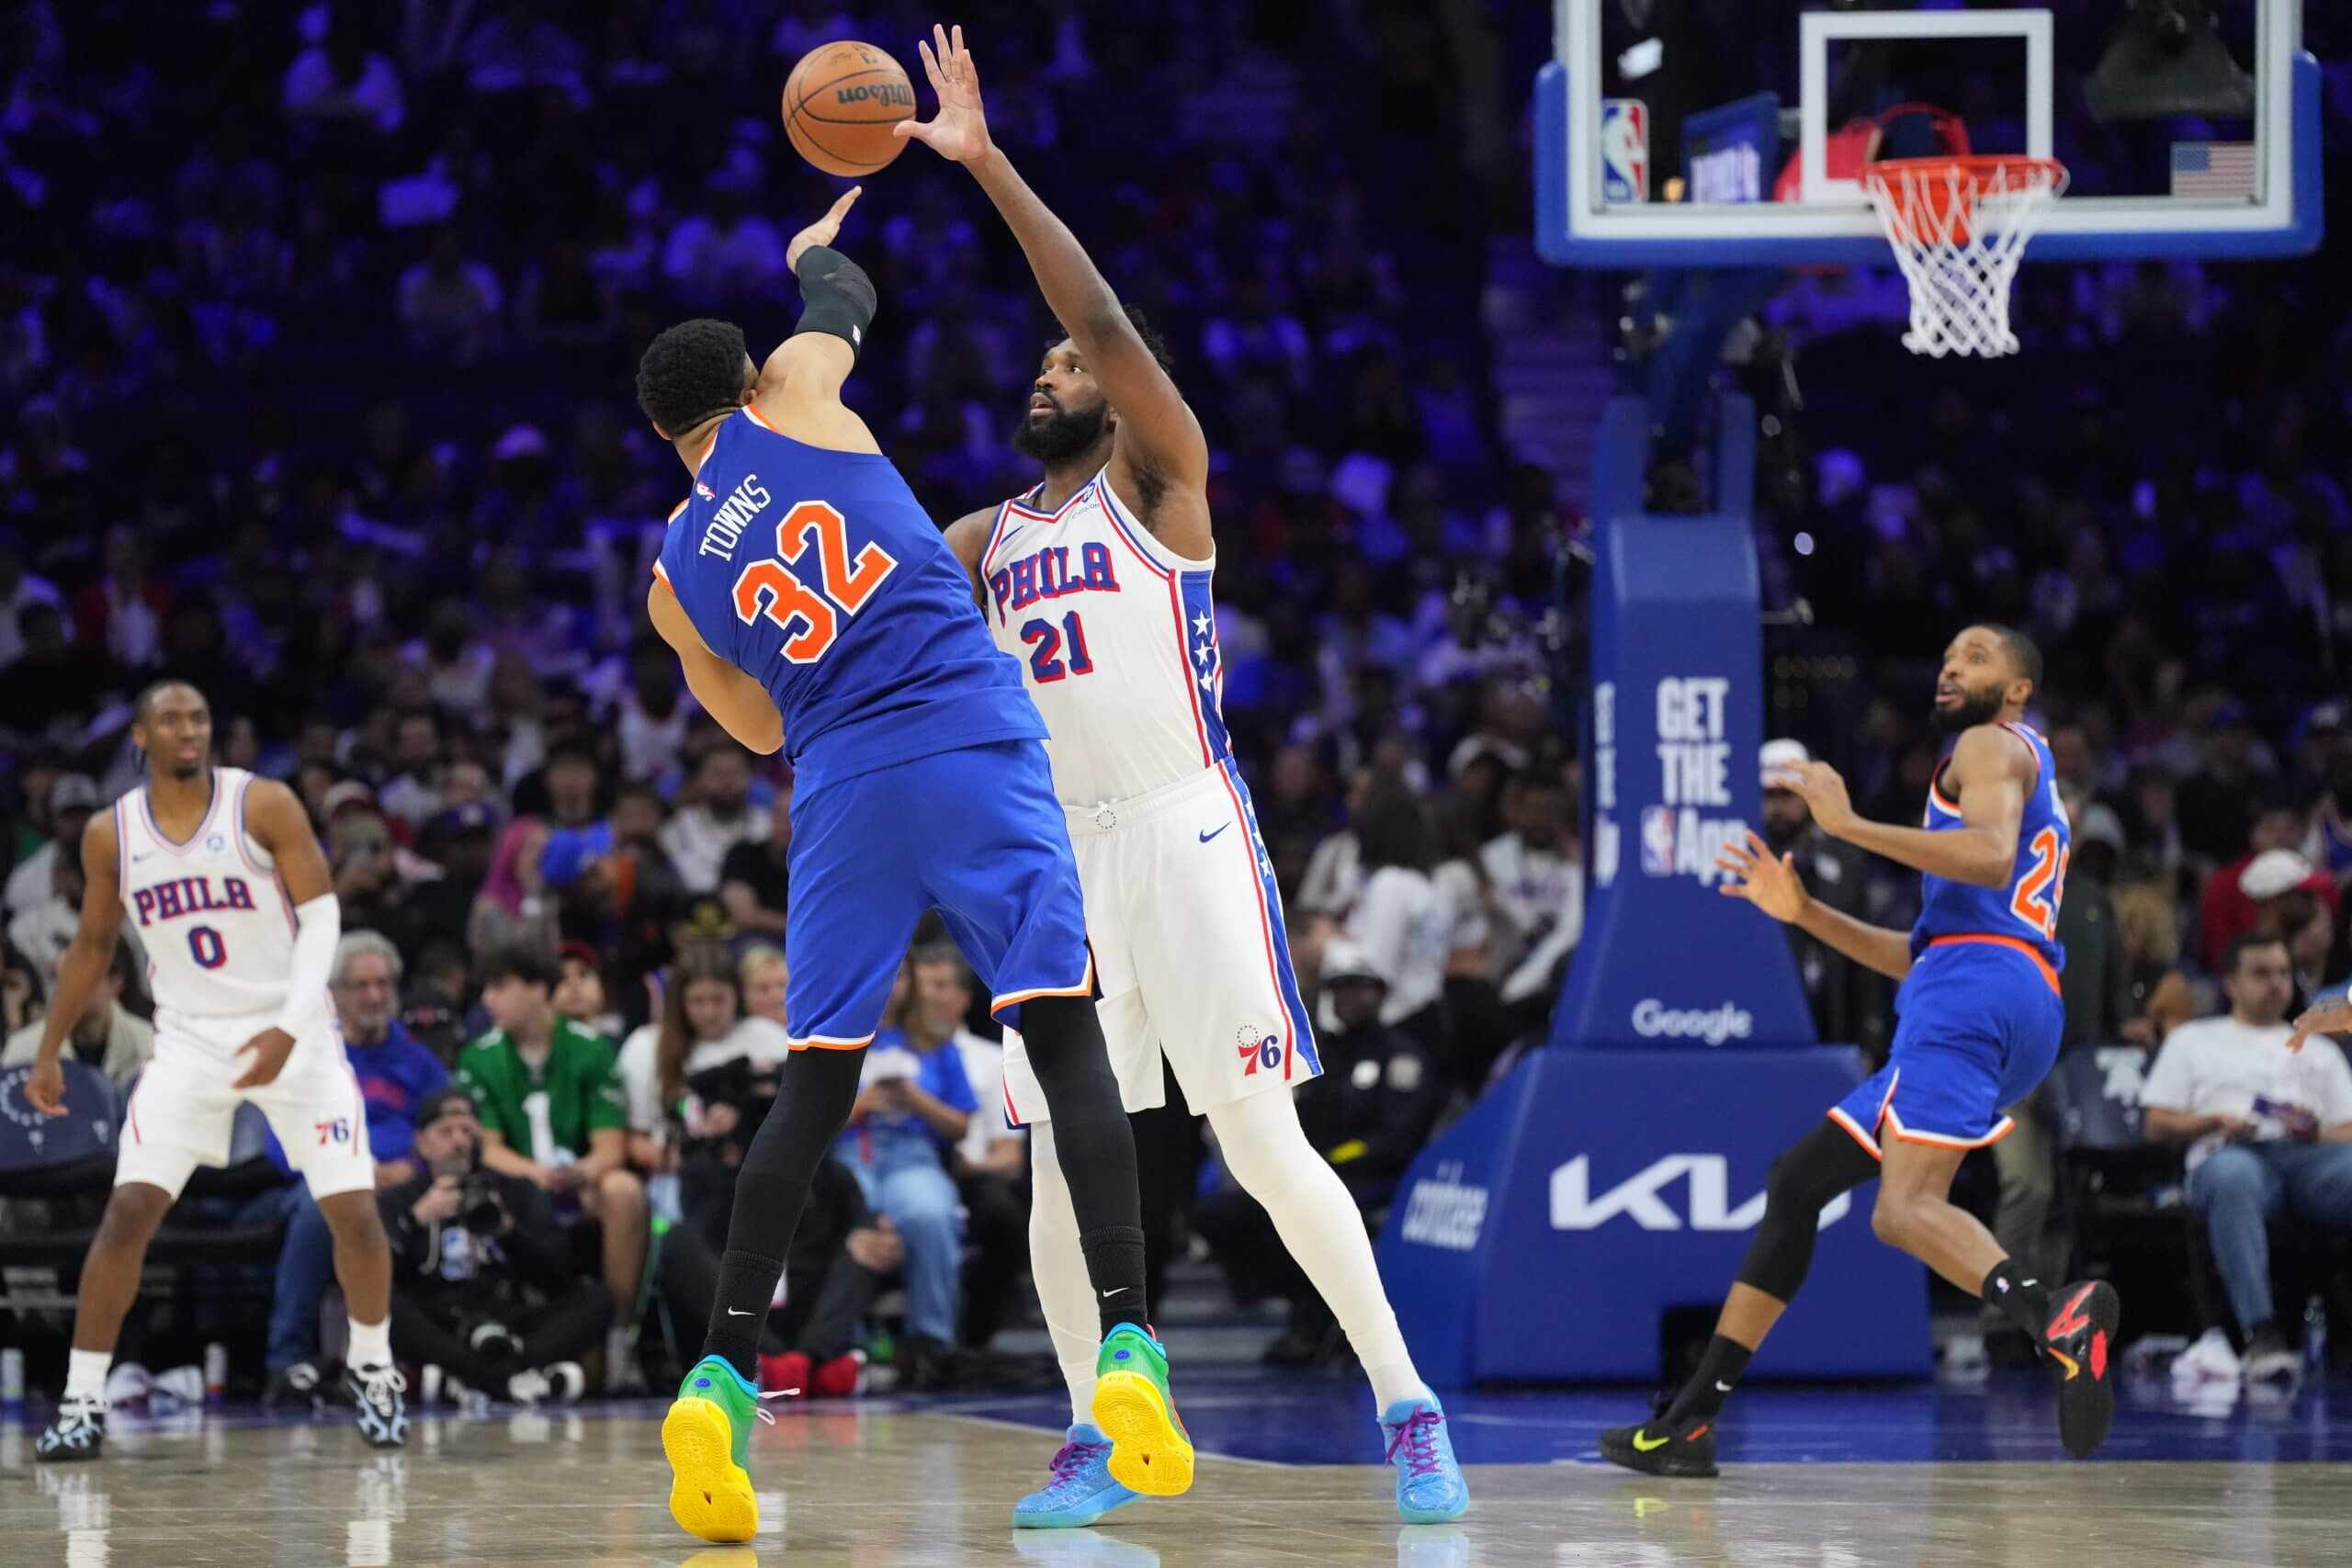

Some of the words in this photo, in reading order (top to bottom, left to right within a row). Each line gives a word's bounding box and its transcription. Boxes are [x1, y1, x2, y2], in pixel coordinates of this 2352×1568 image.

[836, 83, 912, 107] Wilson
[699, 473, 772, 562] TOWNS
[732, 500, 899, 664] 32
[989, 542, 1121, 628] PHILA
[1020, 610, 1093, 683] 21
[1657, 677, 1729, 739] GET
[1657, 741, 1732, 807] THE
[132, 875, 256, 927] PHILA
[187, 925, 227, 970] 0
[1631, 998, 1753, 1046] Google
[1237, 1034, 1282, 1077] 76
[314, 1118, 350, 1146] 76
[523, 1090, 553, 1168] 1
